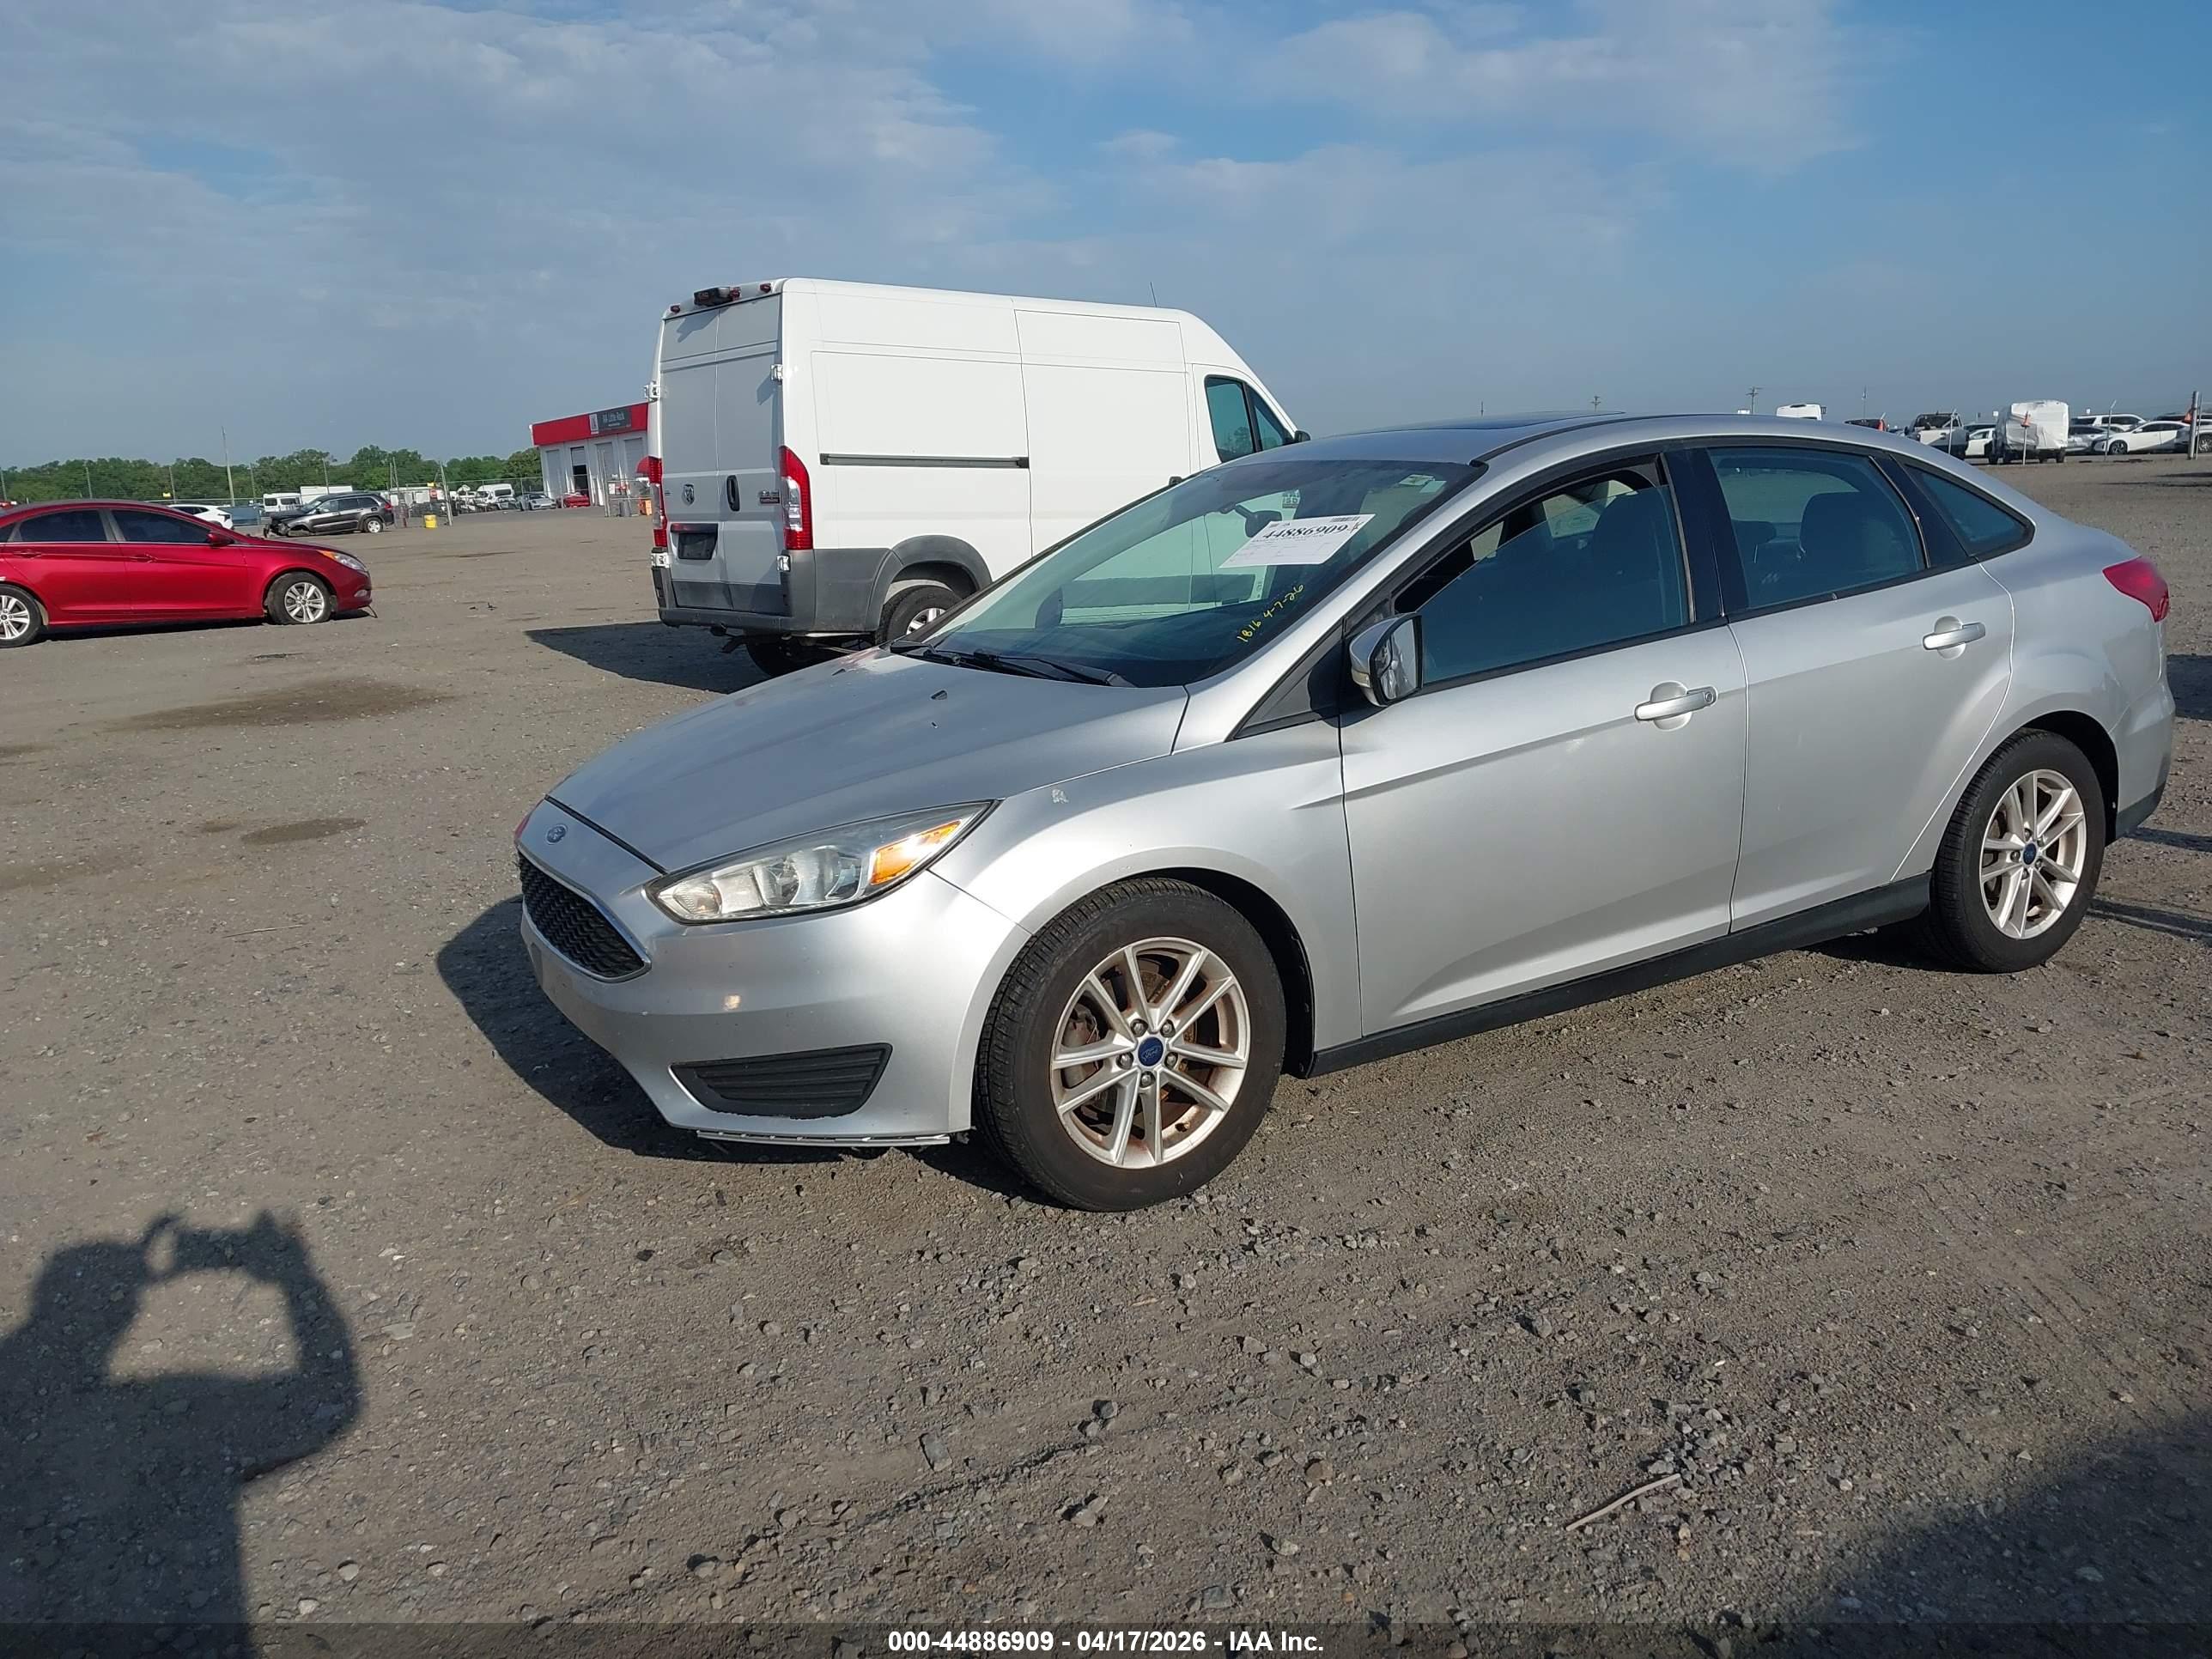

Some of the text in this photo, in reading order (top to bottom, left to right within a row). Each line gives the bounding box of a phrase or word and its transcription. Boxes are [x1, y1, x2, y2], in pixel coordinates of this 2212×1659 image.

[1262, 524, 1349, 539] 44886909
[1237, 584, 1304, 642] 1816 4-7-26
